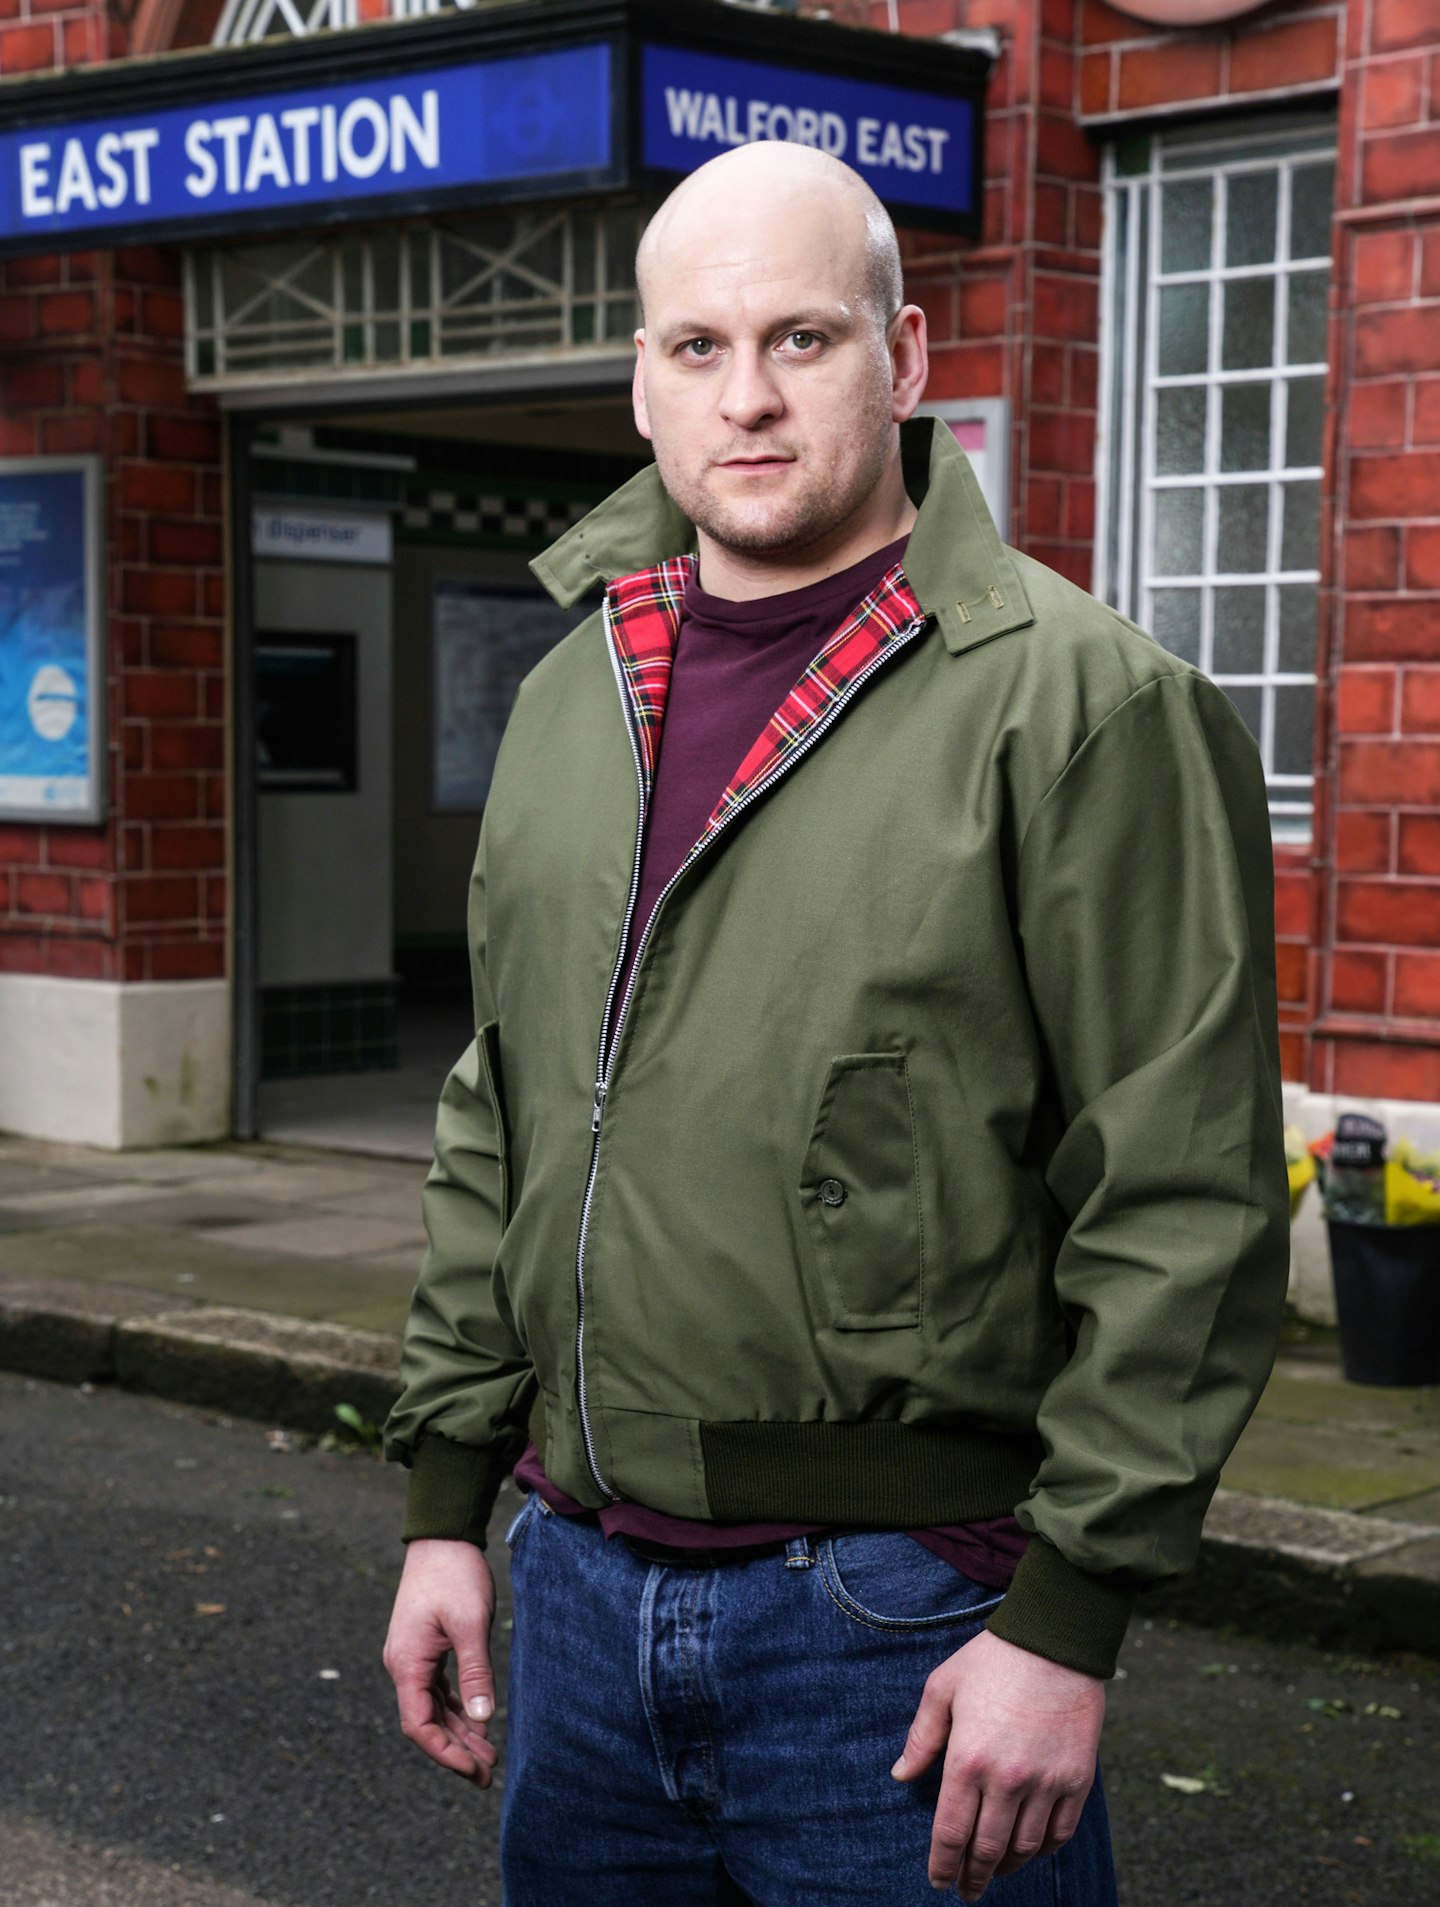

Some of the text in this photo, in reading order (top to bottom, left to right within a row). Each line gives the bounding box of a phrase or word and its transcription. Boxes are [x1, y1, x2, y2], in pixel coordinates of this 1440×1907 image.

[19, 90, 440, 218] EAST STATION
[664, 86, 949, 174] WALFORD EAST
